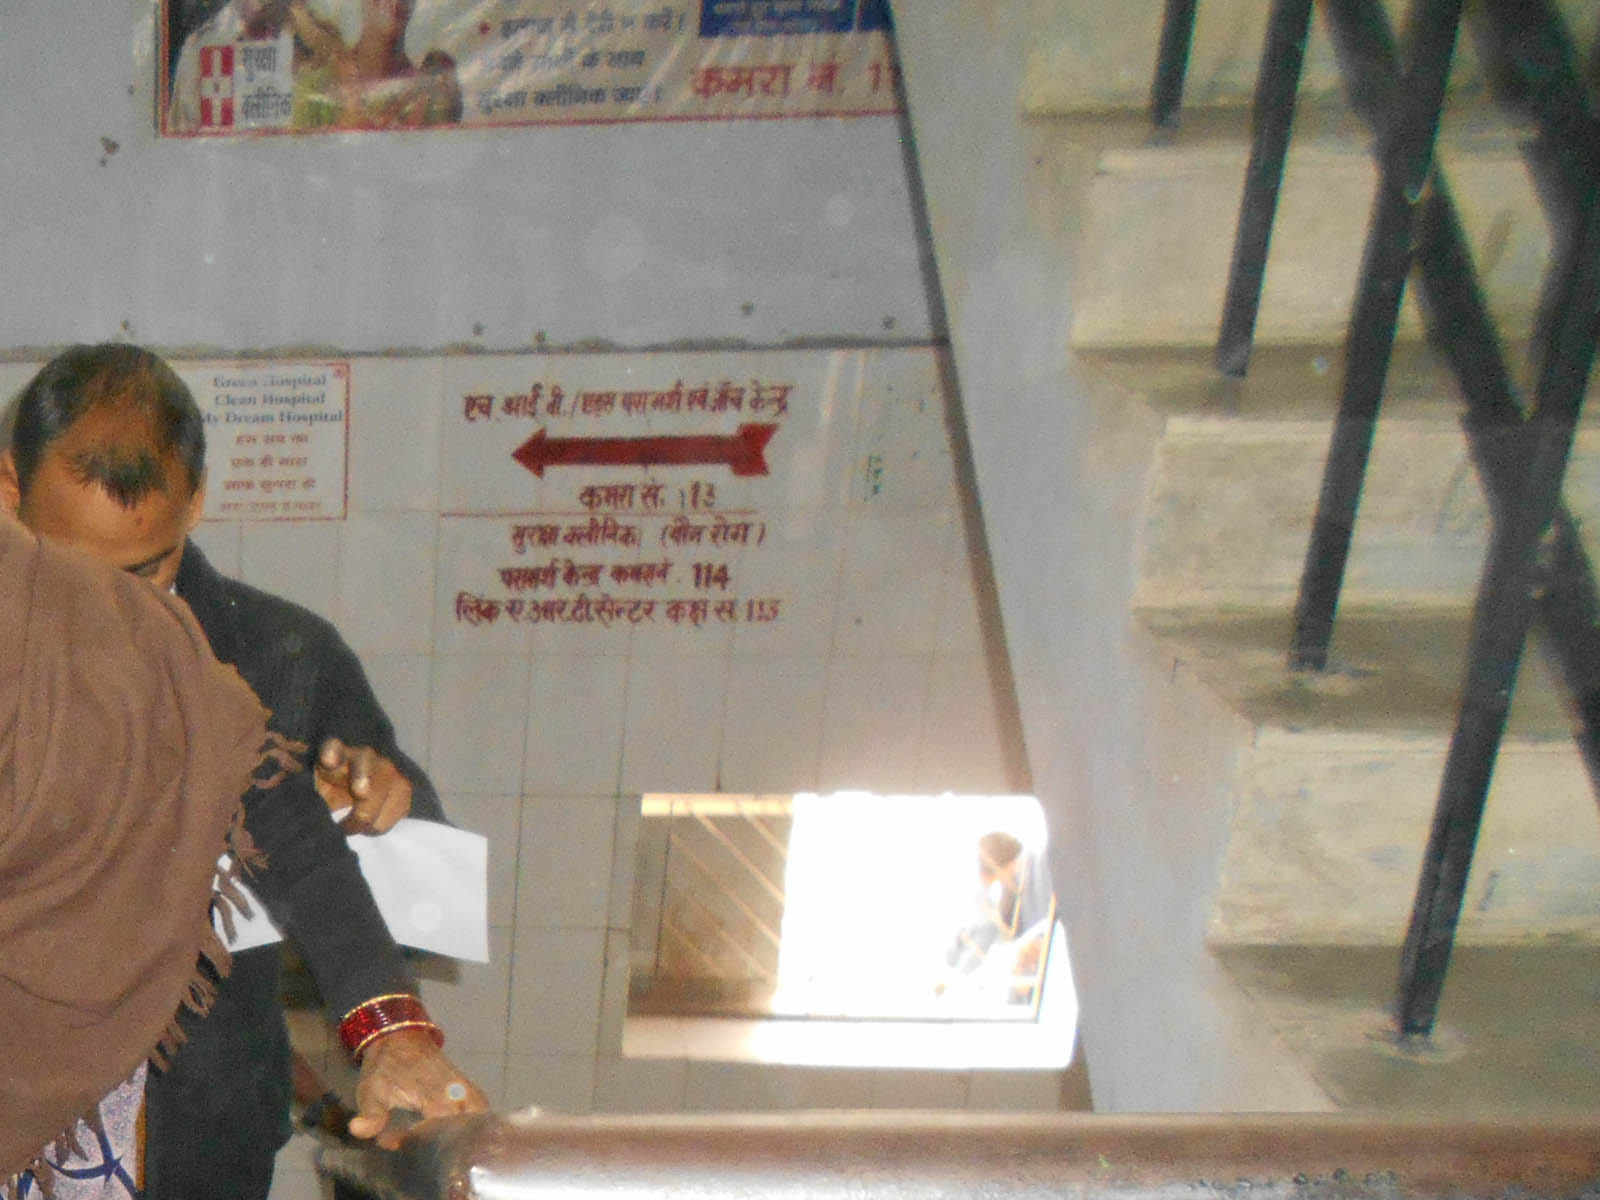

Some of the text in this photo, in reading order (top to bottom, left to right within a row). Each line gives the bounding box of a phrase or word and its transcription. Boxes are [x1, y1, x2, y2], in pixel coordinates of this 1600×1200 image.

[691, 63, 793, 99] कमरा
[215, 392, 326, 409] Clean Hospital
[225, 411, 275, 424] Dream
[279, 410, 346, 427] Hospital
[578, 484, 636, 511] कमरा
[511, 524, 561, 554] सुरक्षा
[692, 562, 732, 591] 114
